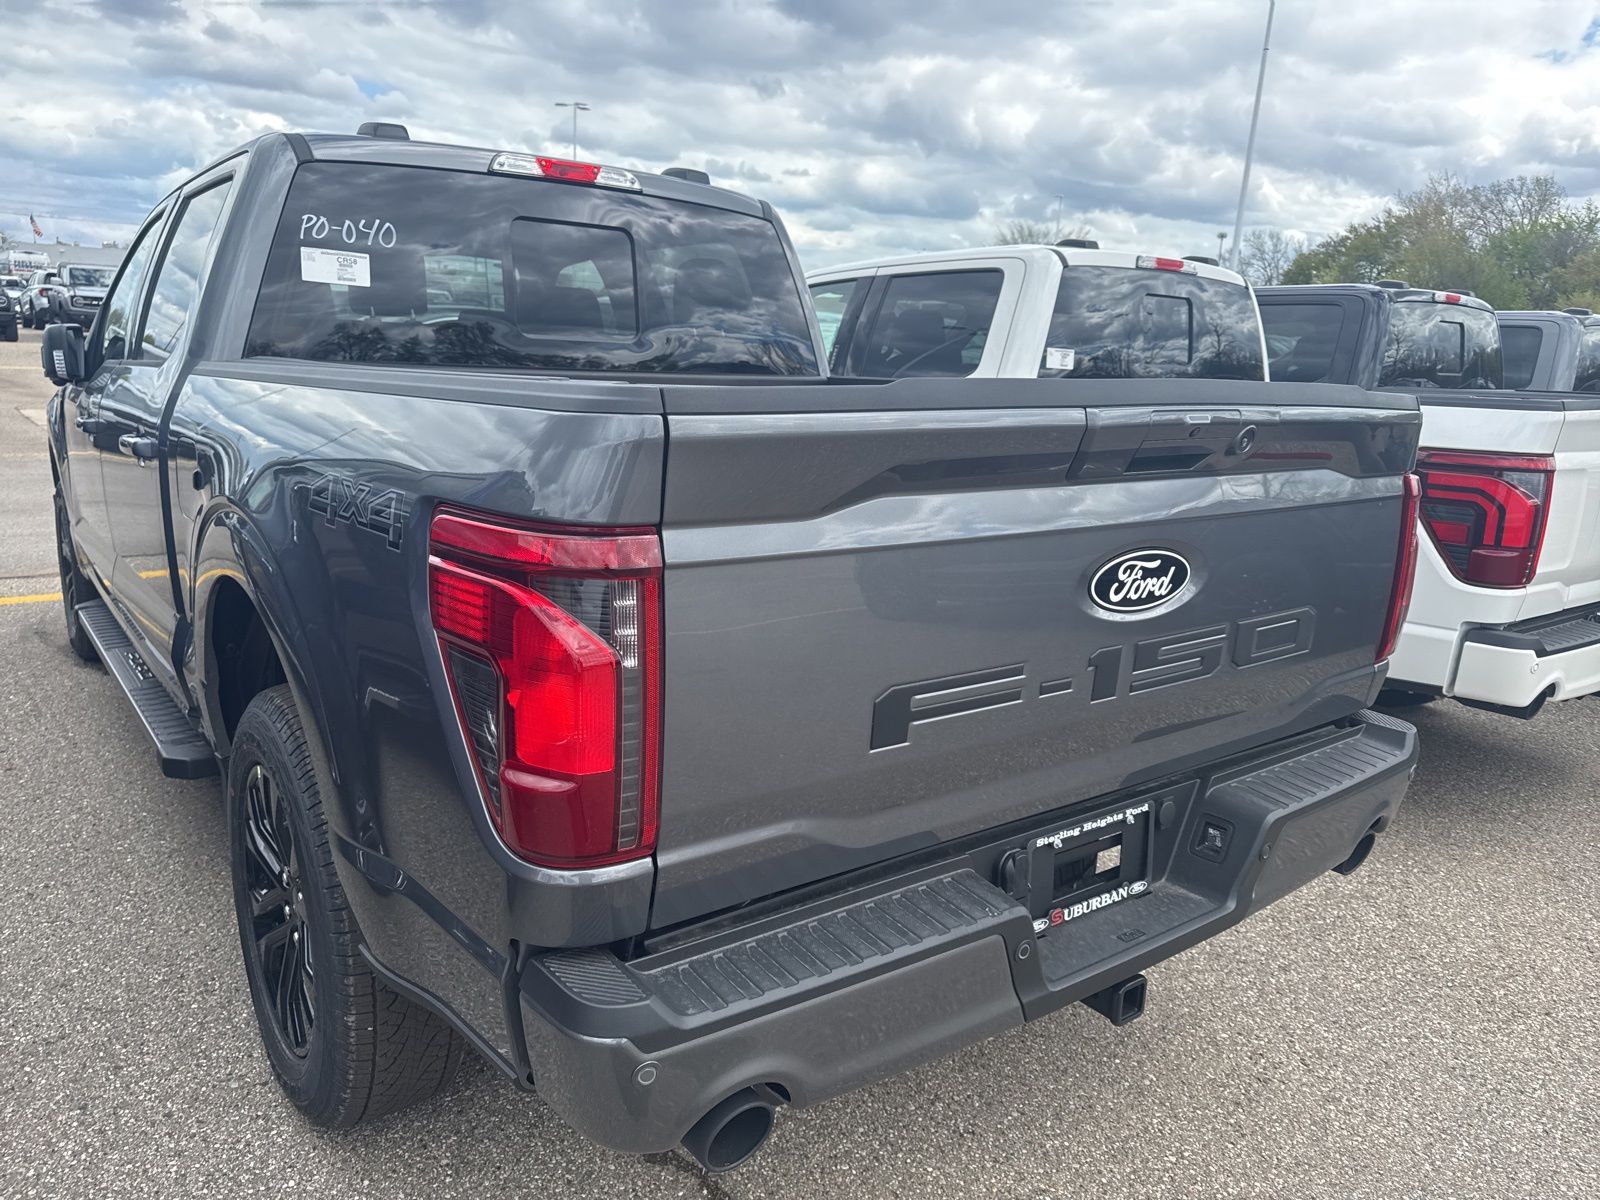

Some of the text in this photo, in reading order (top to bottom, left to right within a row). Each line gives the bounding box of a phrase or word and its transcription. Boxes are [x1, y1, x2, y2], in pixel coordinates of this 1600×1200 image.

[1108, 559, 1176, 603] Ford
[869, 606, 1317, 753] F-150
[1036, 803, 1149, 848] Sterling Heights Ford
[1051, 886, 1129, 928] SUBURBAN
